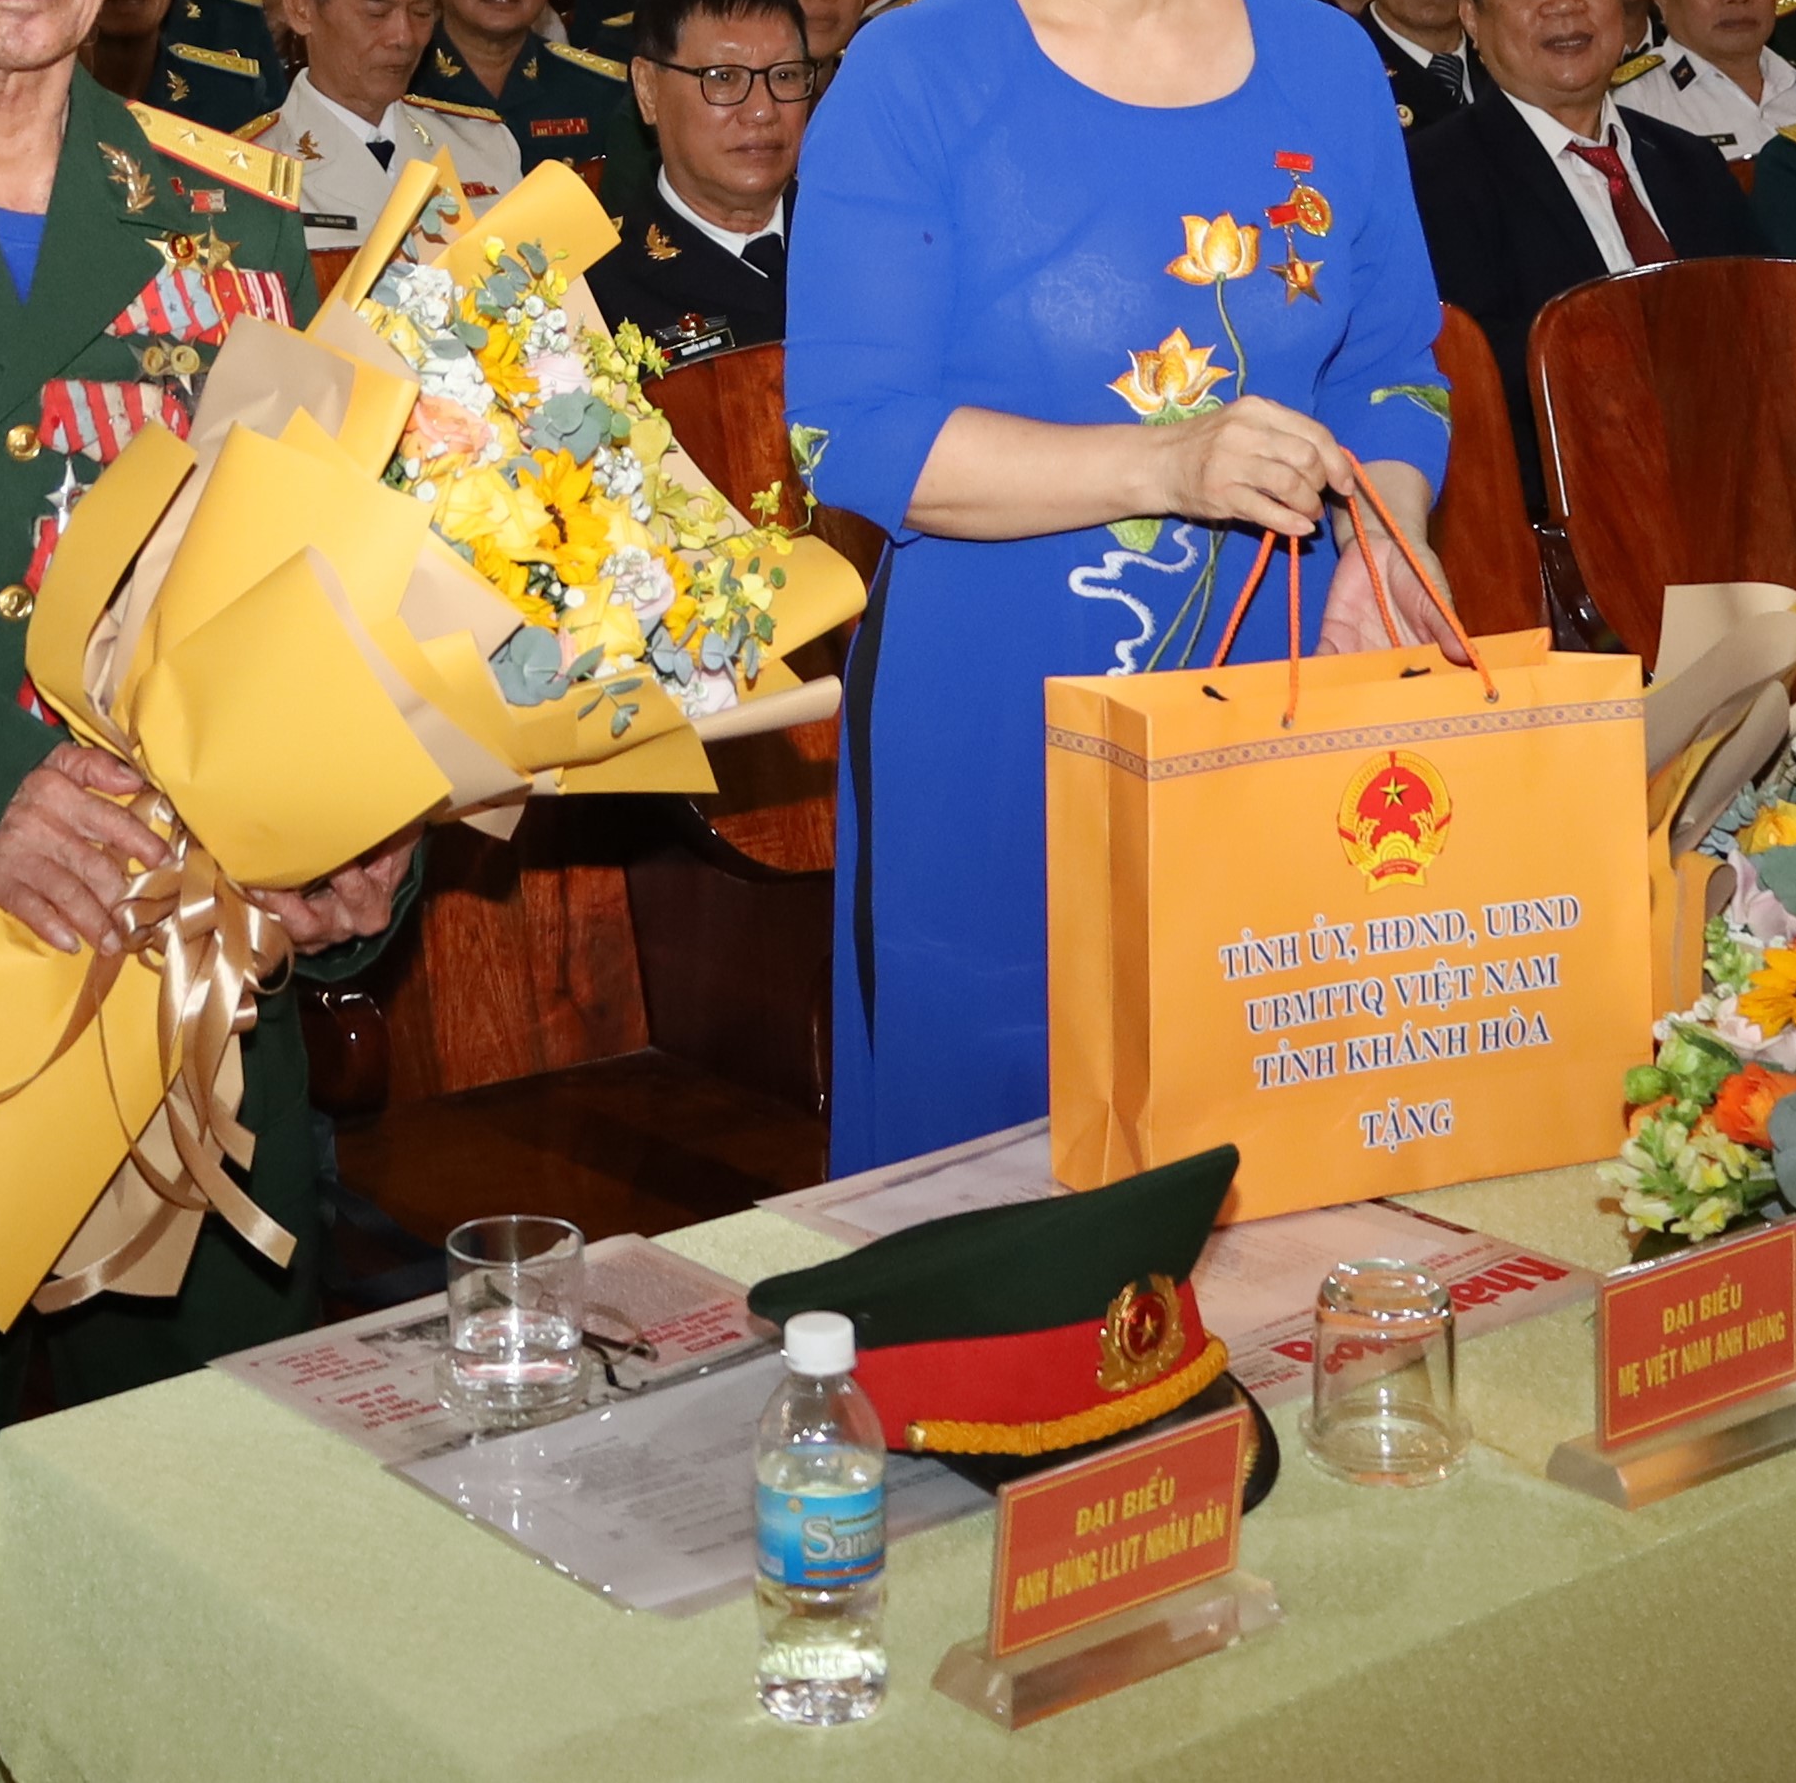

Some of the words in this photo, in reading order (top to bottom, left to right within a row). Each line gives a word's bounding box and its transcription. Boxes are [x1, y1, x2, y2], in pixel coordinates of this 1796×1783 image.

[1220, 928, 1300, 980] TỈNH
[1309, 914, 1357, 962] ỦY,
[1365, 909, 1476, 955] HĐND,
[1483, 895, 1581, 939] UBND
[1245, 979, 1385, 1034] UBMTTQ
[1392, 960, 1475, 1010] VIỆT
[1483, 954, 1560, 997] NAM
[1254, 1039, 1338, 1090] TỈNH
[1345, 1021, 1470, 1073] KHÁNH
[1478, 1007, 1551, 1053] HÒA
[1360, 1098, 1453, 1153] TẶNG
[1663, 1299, 1695, 1335] ĐẠI
[1700, 1273, 1743, 1322] BIỂU
[1645, 1344, 1678, 1388] VIỆT
[1075, 1497, 1116, 1536] ĐẠI
[1122, 1466, 1176, 1521] BIỂU
